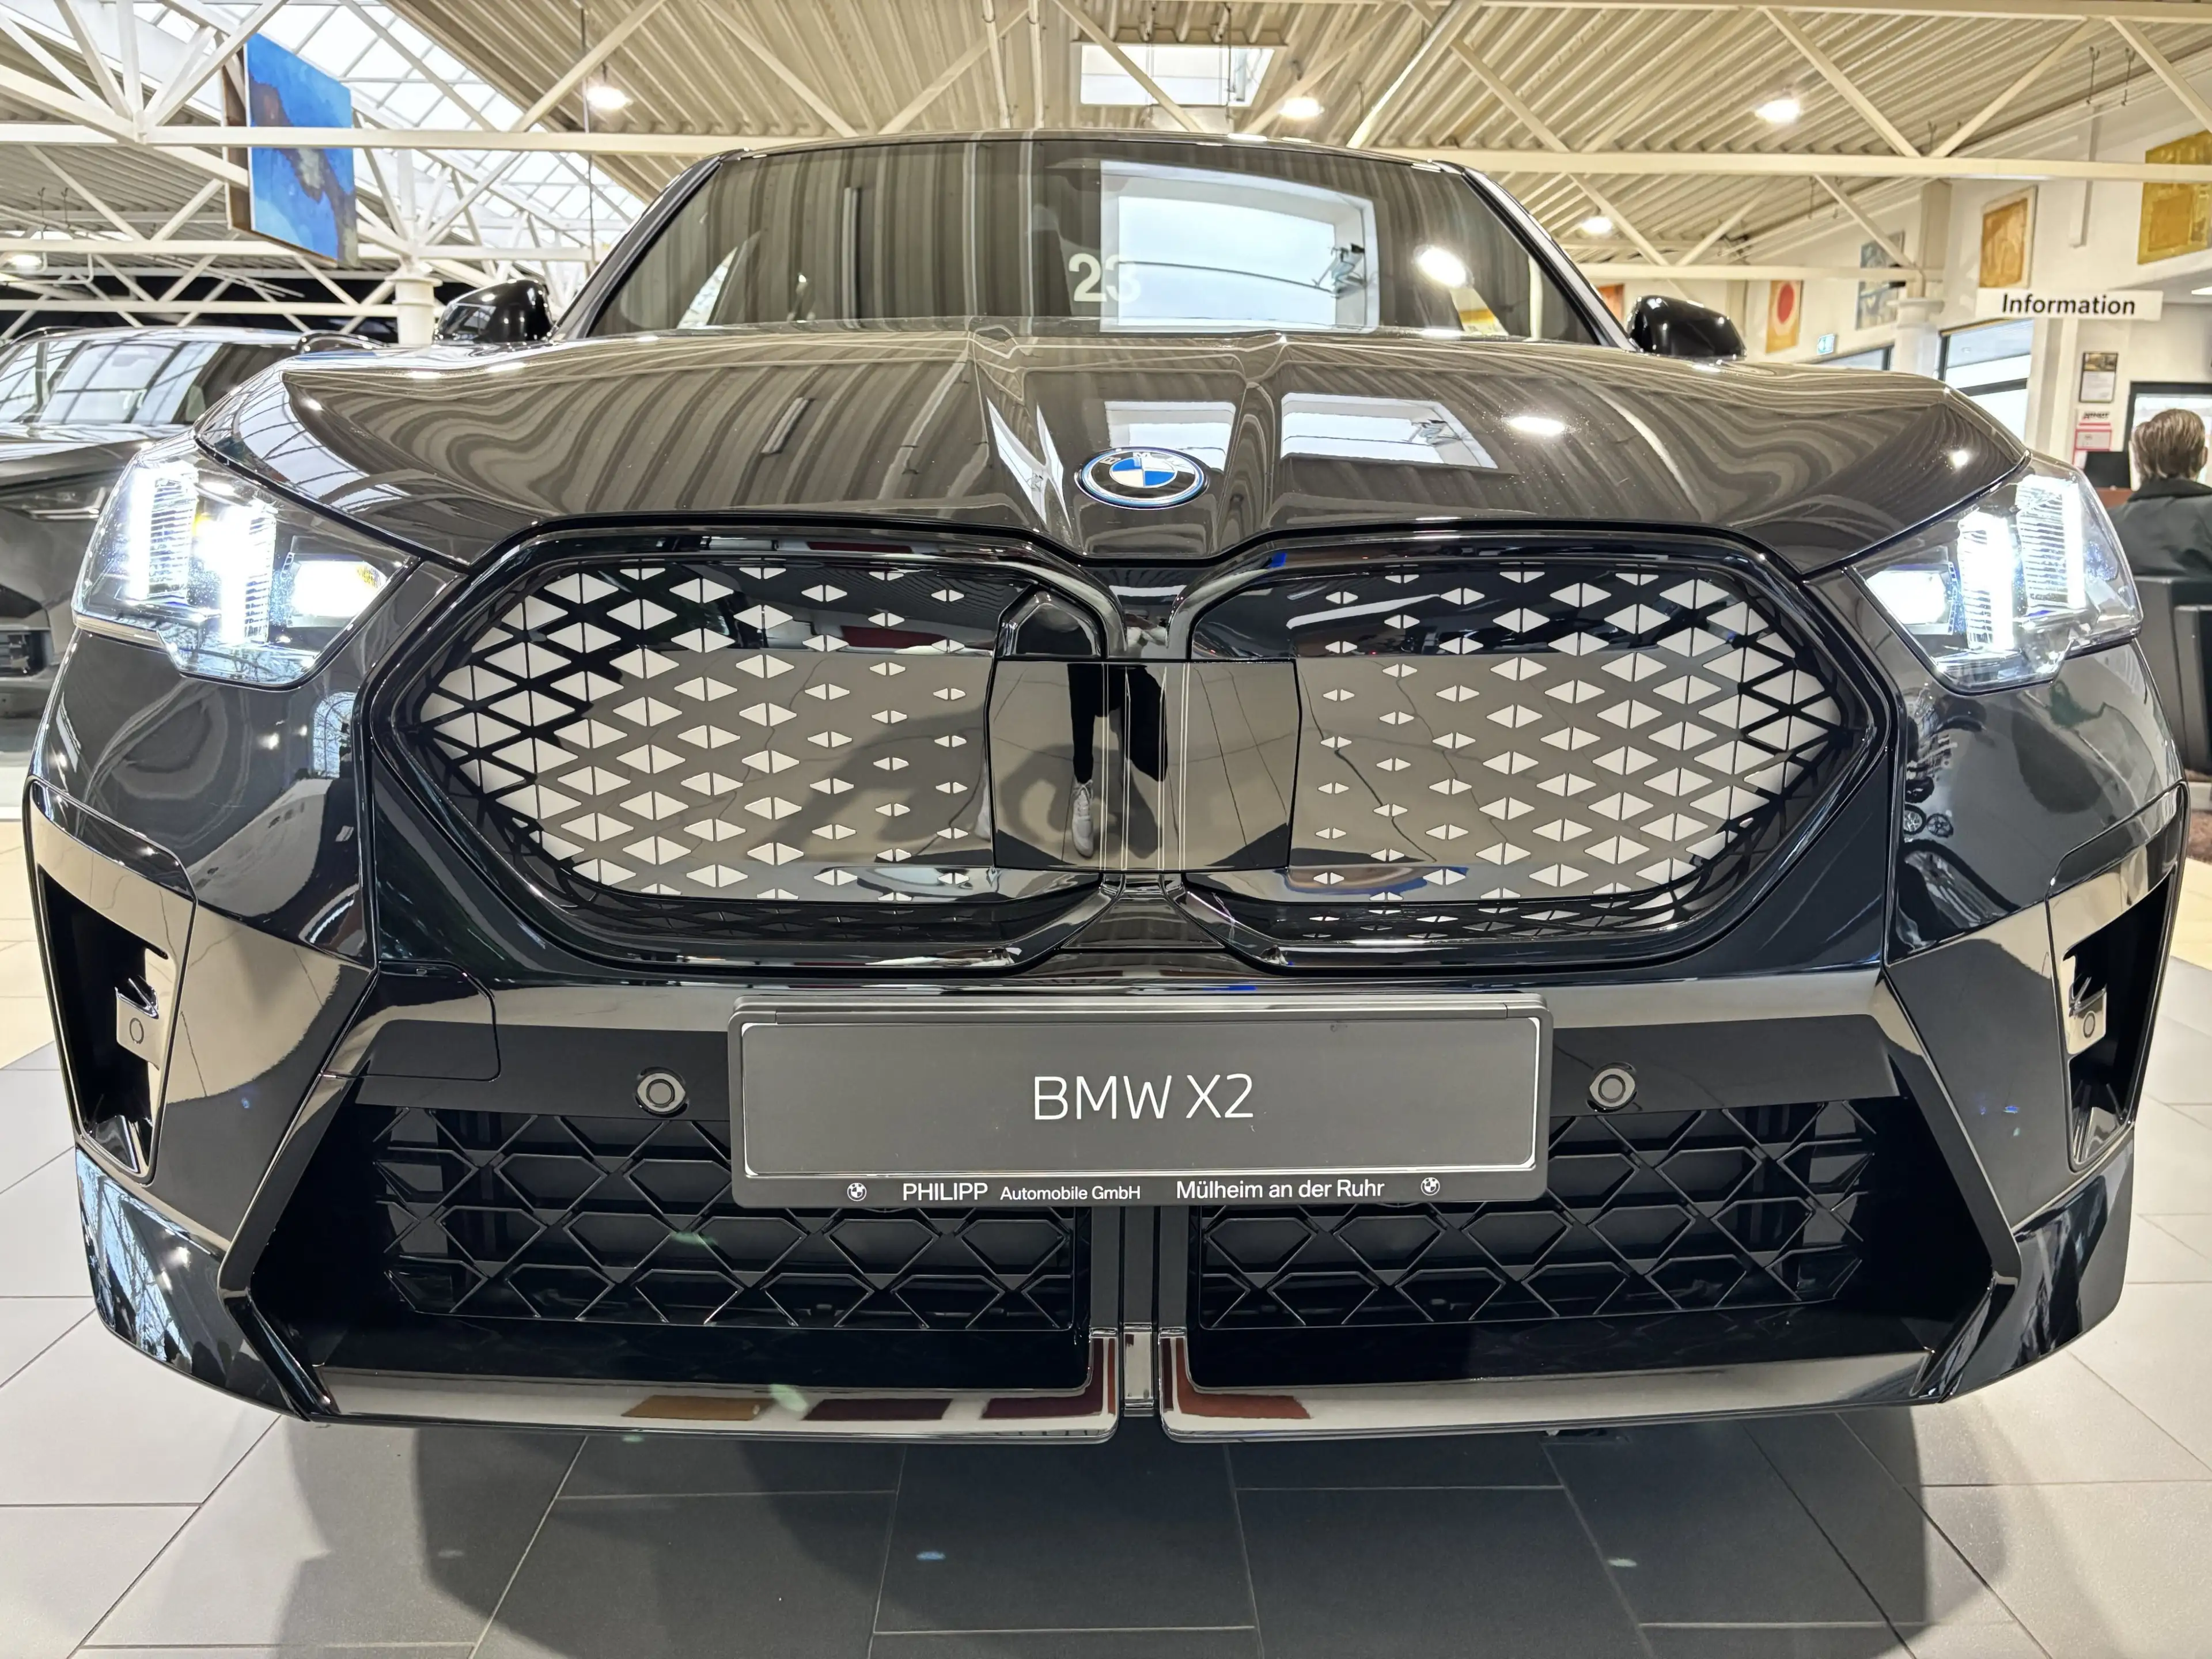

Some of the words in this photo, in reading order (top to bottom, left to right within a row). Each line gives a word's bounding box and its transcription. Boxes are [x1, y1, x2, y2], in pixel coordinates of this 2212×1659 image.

[2002, 293, 2135, 315] Information
[1035, 1075, 1172, 1119] BMW
[1186, 1074, 1253, 1118] X2
[904, 1183, 987, 1200] PHILIPP
[1000, 1186, 1088, 1200] Automobile
[1092, 1186, 1140, 1199] GmbH
[1177, 1180, 1262, 1198] Mülheim
[1269, 1184, 1292, 1198] an
[1298, 1180, 1332, 1197] der
[1338, 1179, 1385, 1196] Ruhr
